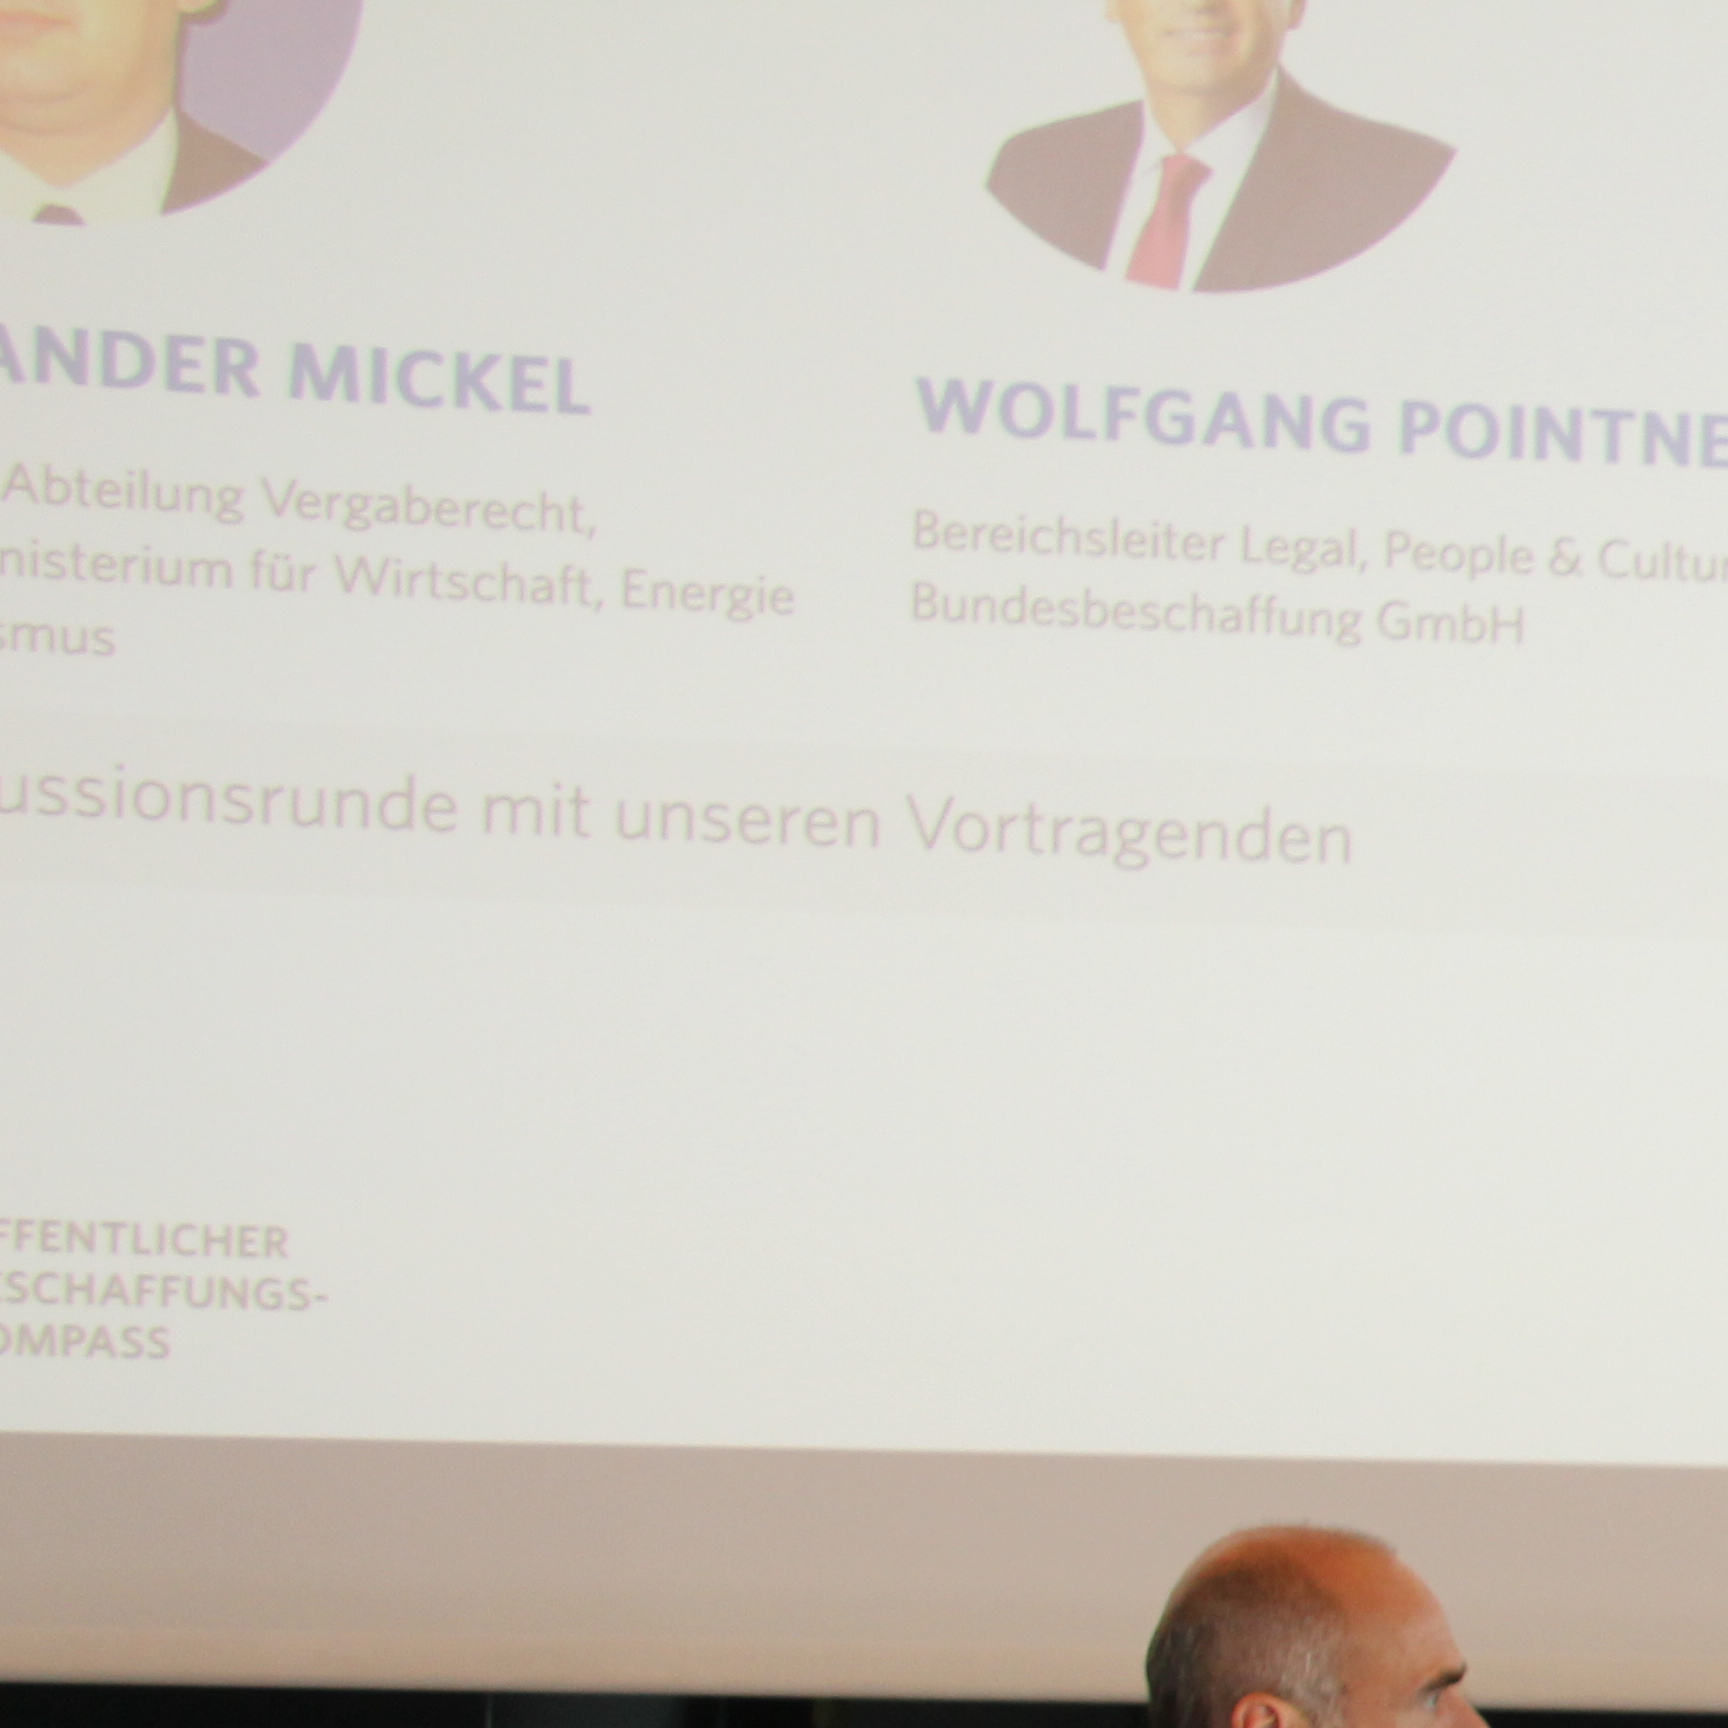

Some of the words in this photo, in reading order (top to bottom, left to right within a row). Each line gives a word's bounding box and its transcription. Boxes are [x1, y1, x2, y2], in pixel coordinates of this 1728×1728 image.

[287, 342, 589, 414] MICKEL
[915, 377, 1369, 453] WOLFGANG
[2, 461, 243, 524] Abteilung
[259, 476, 595, 538] Vergaberecht,
[912, 508, 1225, 561] Bereichsleiter
[1241, 525, 1367, 575] Legal,
[1385, 529, 1534, 581] People
[1547, 536, 1581, 576] &
[248, 548, 316, 592] für
[332, 553, 603, 611] Wirtschaft,
[621, 567, 794, 622] Energie
[911, 579, 1362, 647] Bundesbeschaffung
[1376, 599, 1524, 644] GmbH
[482, 782, 589, 838] mit
[615, 800, 879, 847] unseren
[905, 794, 1351, 871] Vortragenden
[0, 1270, 326, 1311] SCHAFFUNGS-
